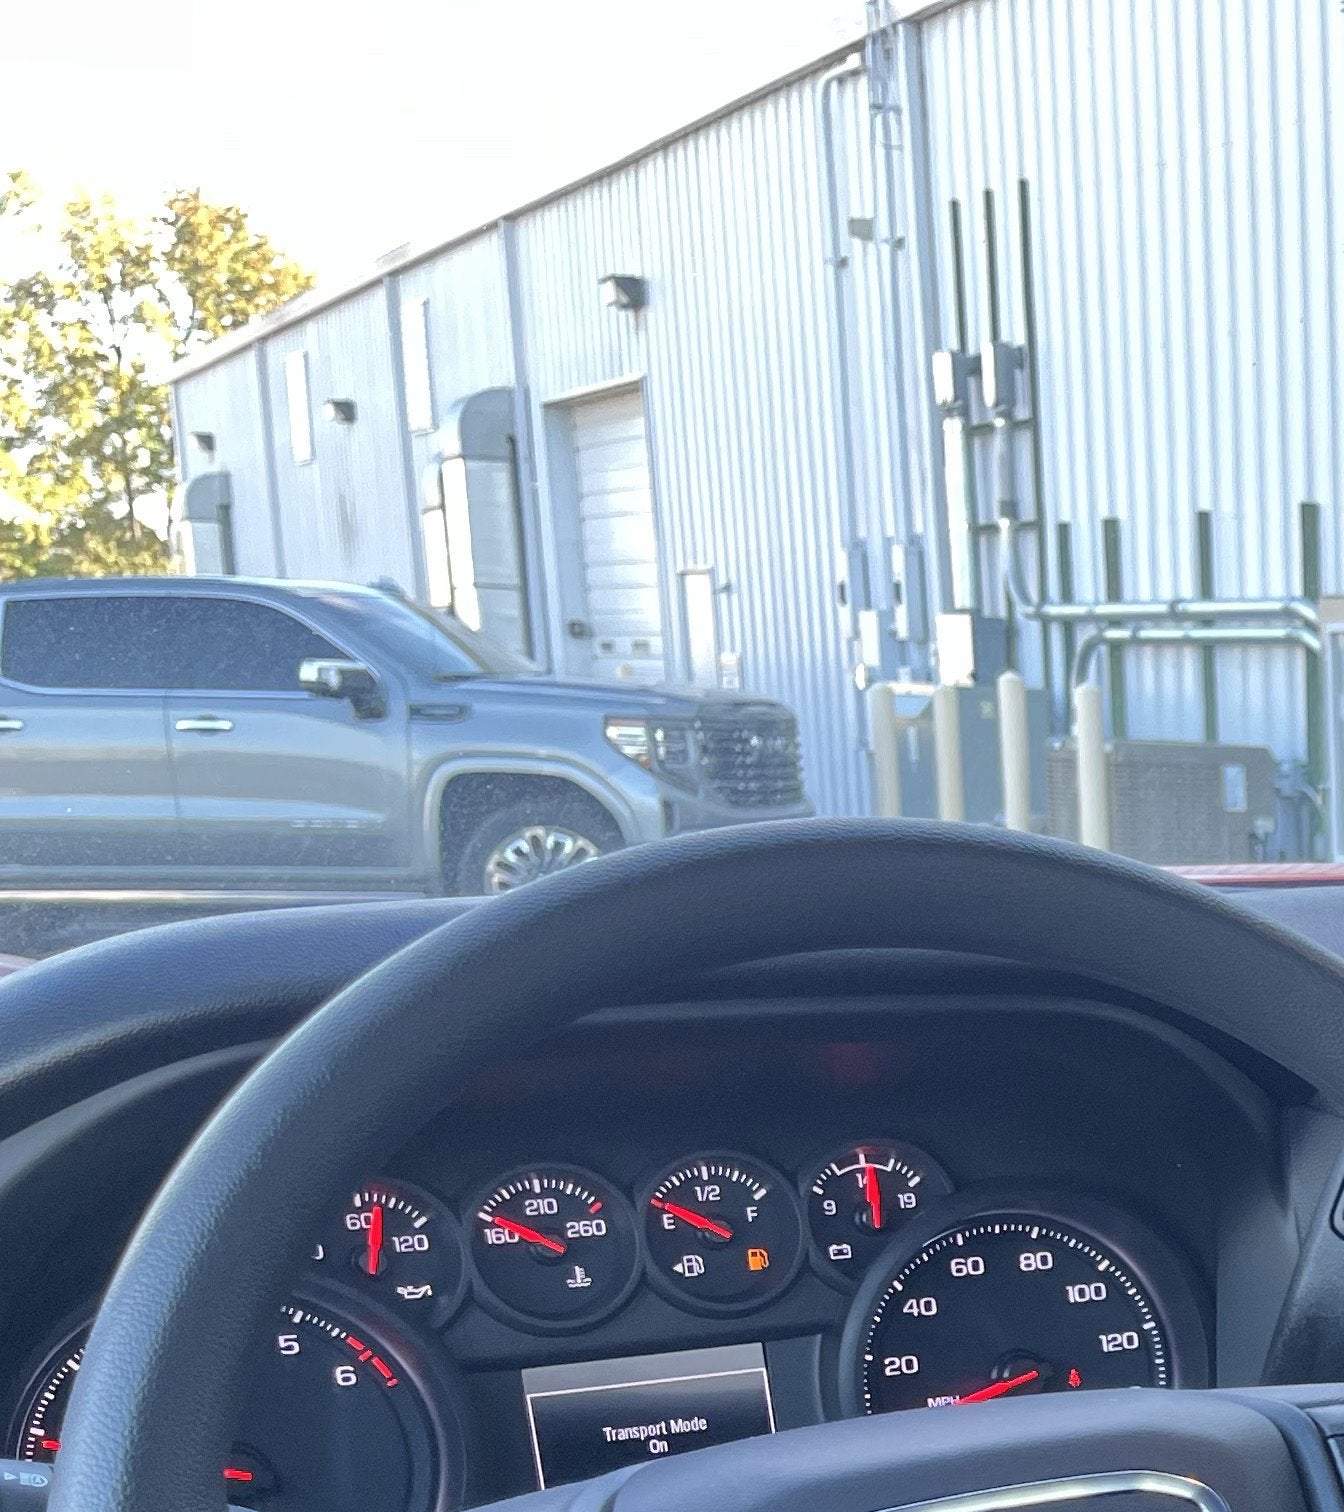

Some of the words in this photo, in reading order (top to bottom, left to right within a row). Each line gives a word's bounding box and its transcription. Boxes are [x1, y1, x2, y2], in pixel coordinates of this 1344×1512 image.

[694, 1184, 721, 1202] 1/2
[898, 1191, 917, 1209] 19
[524, 1197, 558, 1216] 210
[746, 1206, 758, 1223] F
[823, 1199, 837, 1216] 9
[345, 1213, 373, 1231] 60
[566, 1219, 606, 1238] 260
[662, 1213, 676, 1230] E
[392, 1234, 429, 1253] 120
[483, 1227, 519, 1245] 160
[950, 1256, 985, 1278] 60
[1018, 1251, 1054, 1272] 80
[1065, 1282, 1107, 1304] 100
[902, 1296, 938, 1317] 40
[277, 1334, 300, 1356] 5
[1098, 1331, 1139, 1353] 120
[884, 1355, 919, 1377] 20
[335, 1365, 357, 1387] 6
[927, 1394, 961, 1409] MPH
[602, 1421, 667, 1441] Transport
[670, 1416, 708, 1434] Mode
[649, 1439, 668, 1454] On
